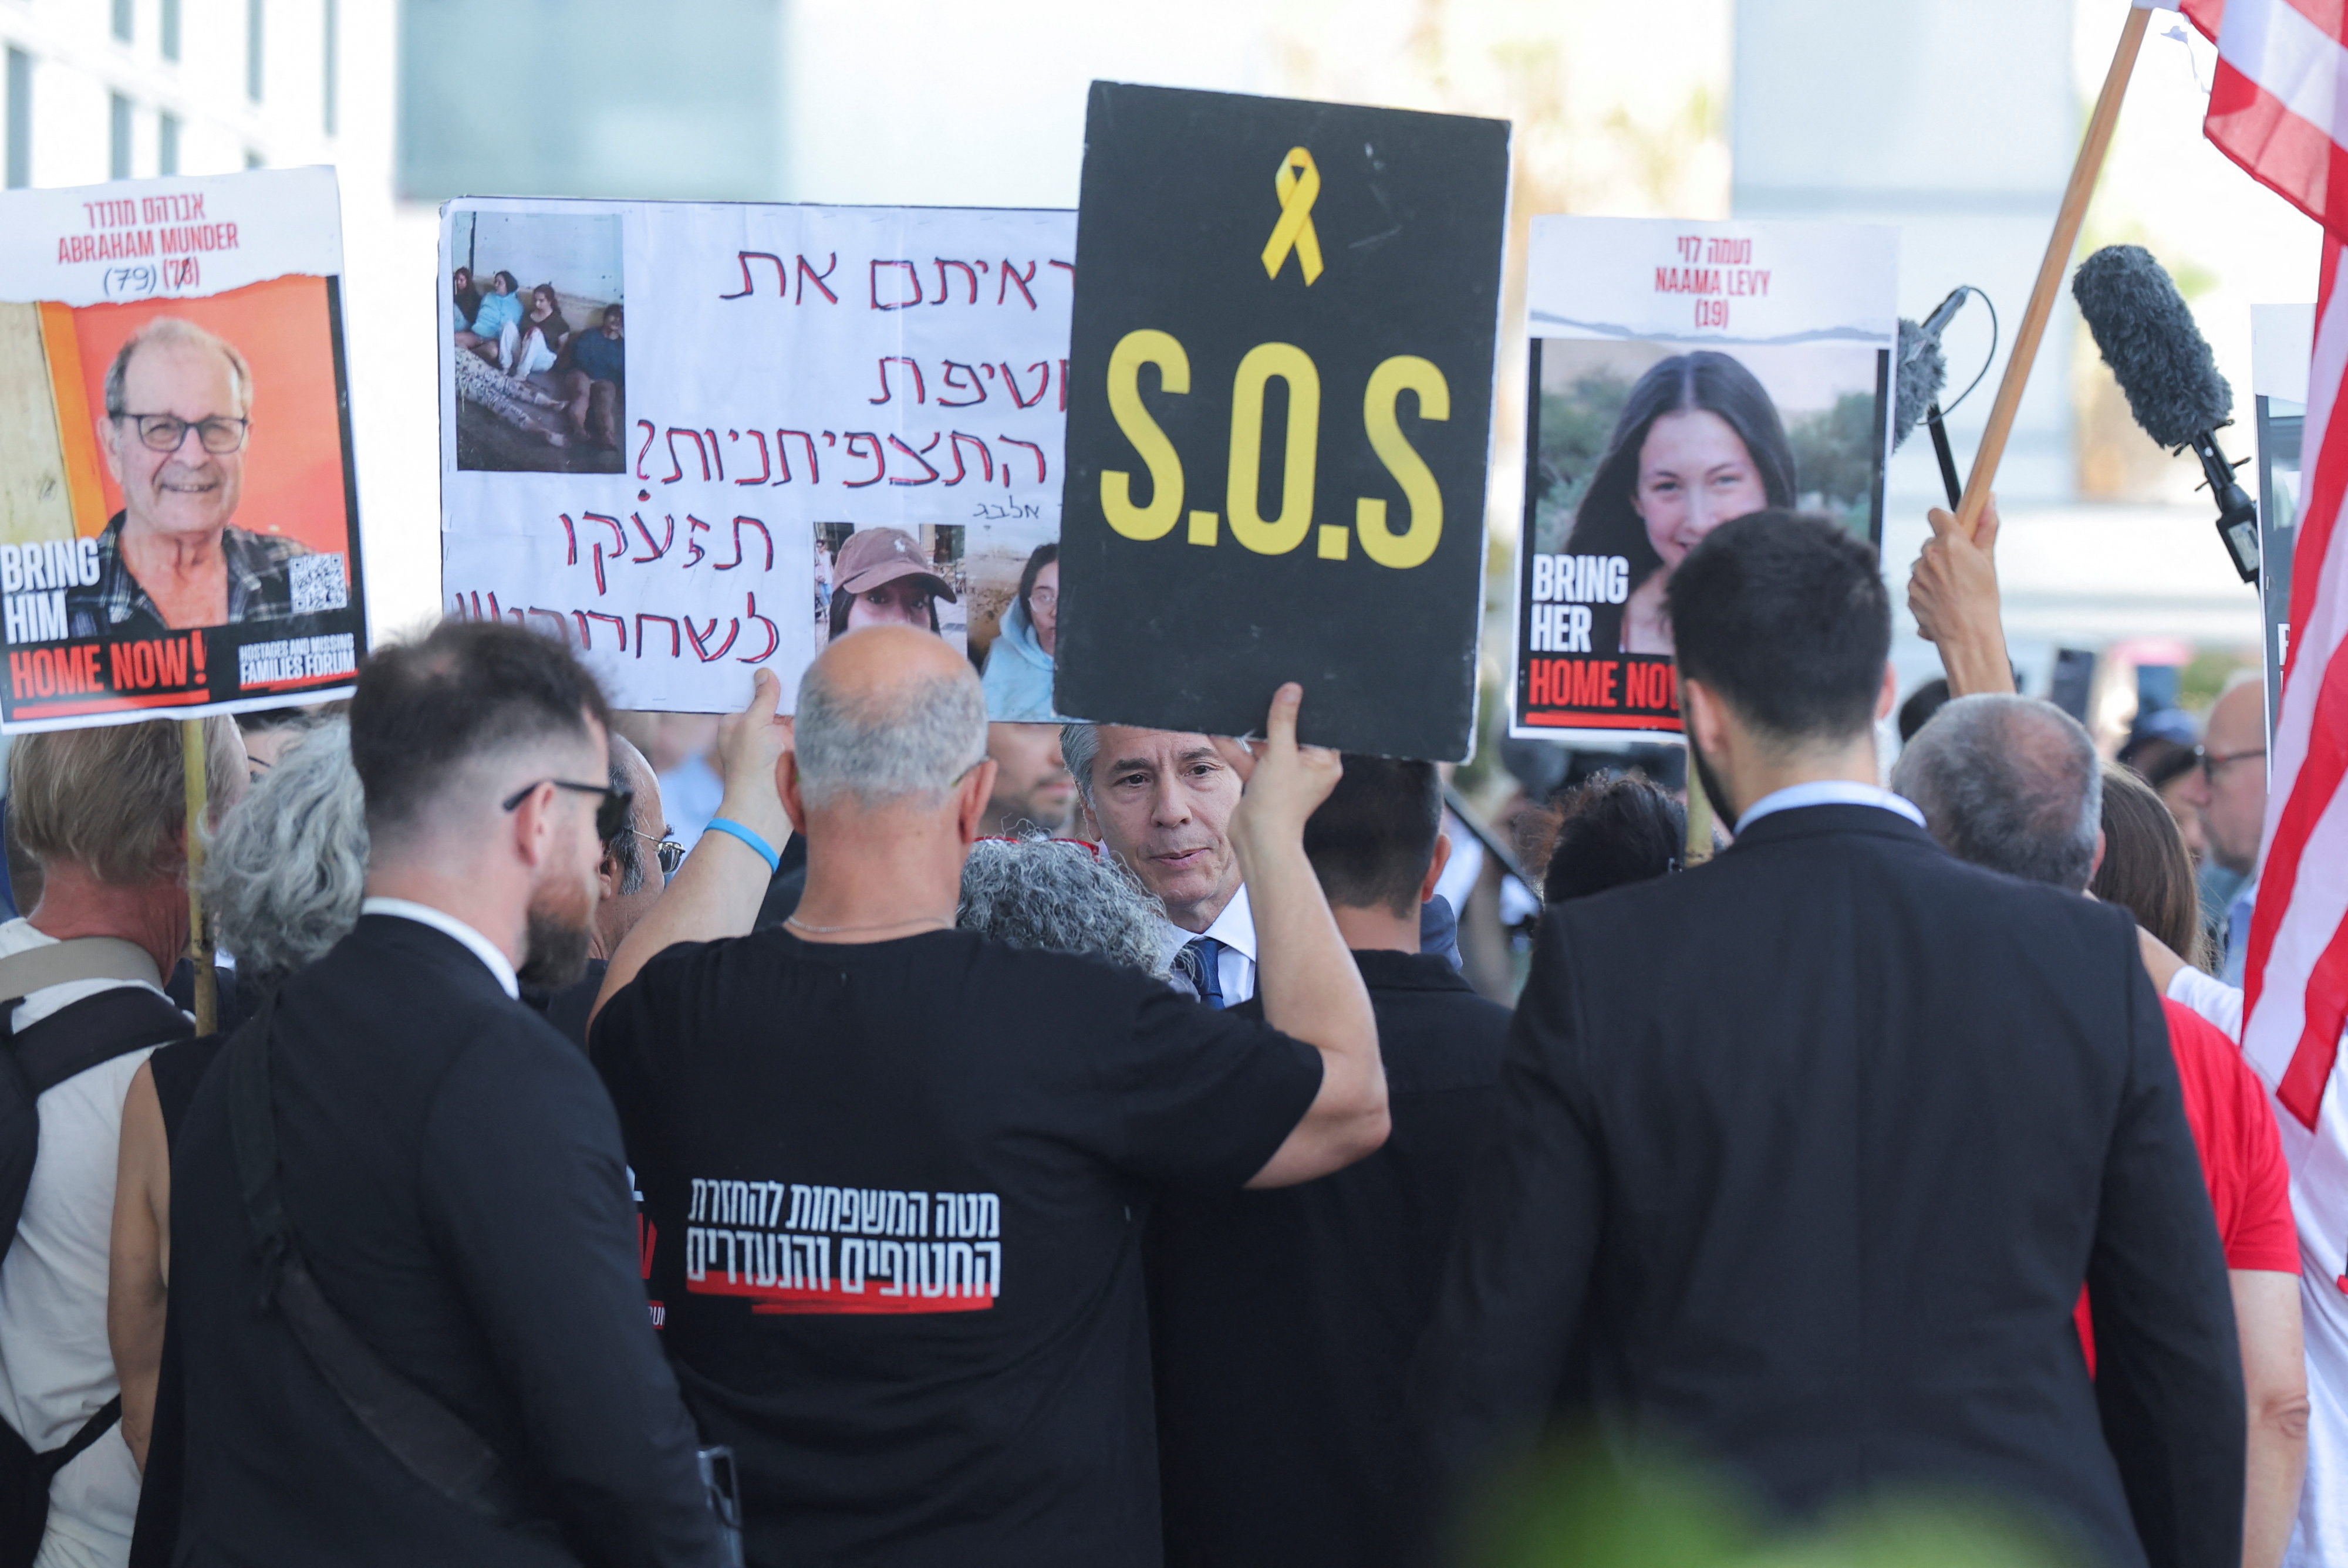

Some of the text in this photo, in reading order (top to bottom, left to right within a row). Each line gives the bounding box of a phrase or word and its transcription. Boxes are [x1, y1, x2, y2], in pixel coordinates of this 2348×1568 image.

[83, 192, 206, 229] אברהם מונדר
[58, 222, 239, 265] ABRAHAM MUNDER
[1678, 235, 1752, 264] נעמה לוי
[103, 263, 157, 297] (79)
[719, 251, 838, 305] את
[1655, 267, 1771, 296] NAAMA LEVY
[1695, 298, 1728, 329] (19)
[637, 420, 1046, 501] התצפיתניות?
[1100, 328, 1450, 569] S.O.S
[1, 536, 101, 593] BRING
[559, 511, 774, 596] תזעקו
[1532, 553, 1629, 604] BRING
[3, 587, 69, 645] HIM
[1530, 603, 1593, 653] HER
[9, 628, 207, 700] HOME NOW!
[239, 632, 355, 663] HOSTAGES AND MISSING
[240, 649, 356, 685] FAMILIES FORUM
[1529, 658, 1619, 707] HOME
[687, 1178, 785, 1228] להחזרת
[785, 1184, 929, 1238] המשפחות
[936, 1192, 1000, 1238] מטה
[686, 1226, 831, 1292] והנעדרים
[840, 1238, 1001, 1298] החטופים
